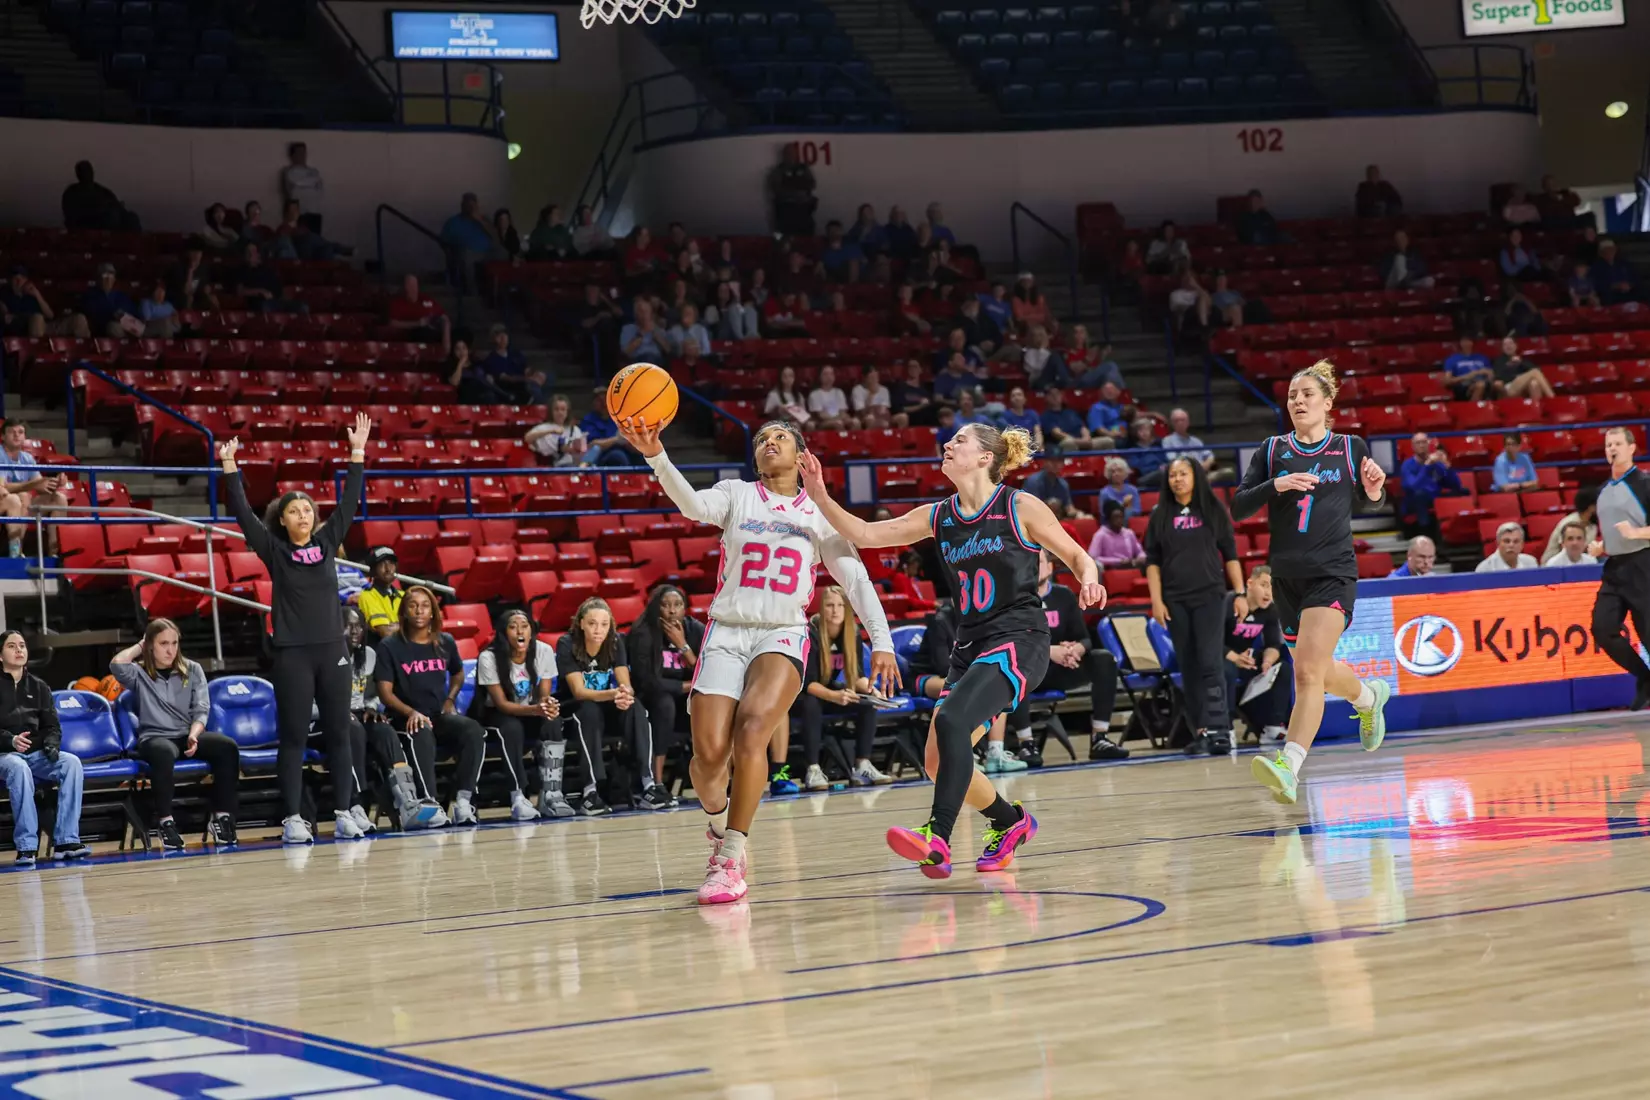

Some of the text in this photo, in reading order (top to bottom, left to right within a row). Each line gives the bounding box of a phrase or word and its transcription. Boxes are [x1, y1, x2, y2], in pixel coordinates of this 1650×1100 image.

[1471, 0, 1613, 25] Super 1 Foods
[1236, 128, 1284, 153] 102
[1297, 494, 1314, 533] 1
[941, 531, 1004, 563] Panthers
[739, 542, 803, 595] 23
[957, 568, 995, 615] 30
[1473, 615, 1601, 662] Kubo
